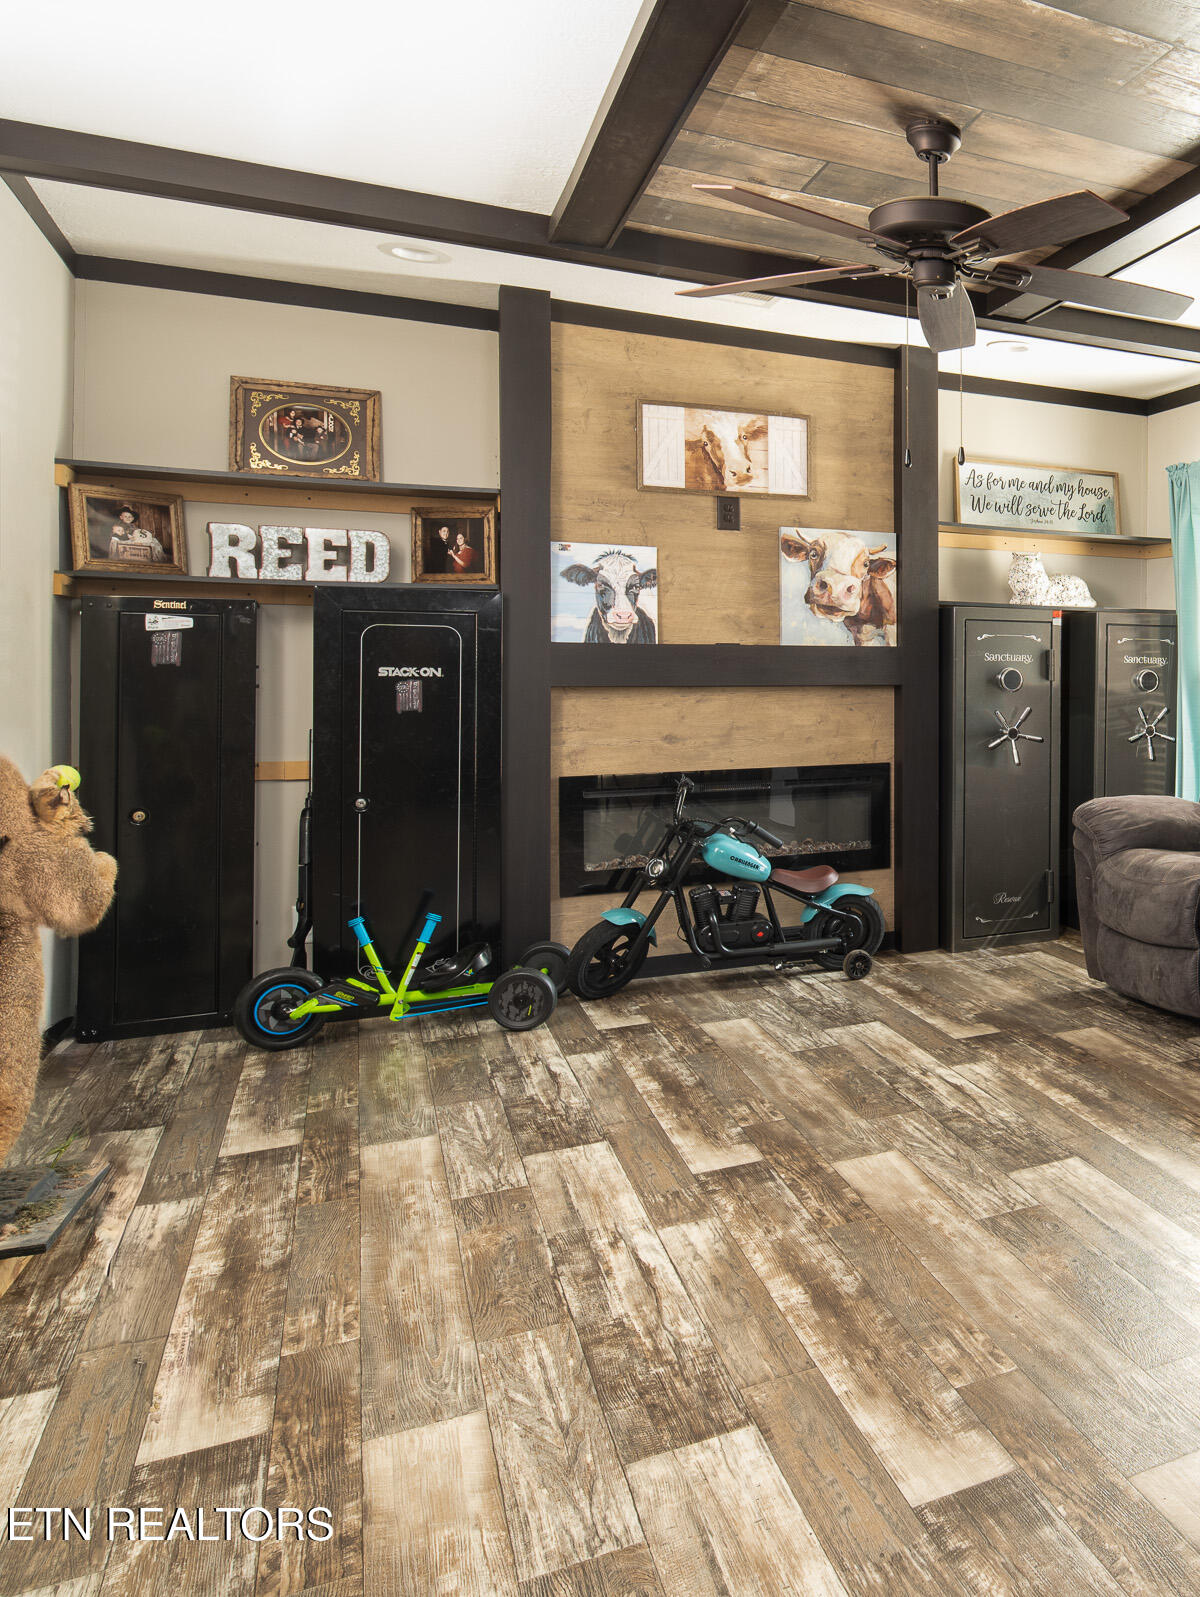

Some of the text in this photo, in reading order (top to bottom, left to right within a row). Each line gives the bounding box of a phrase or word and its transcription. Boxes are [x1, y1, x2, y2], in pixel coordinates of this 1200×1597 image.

[965, 469, 984, 488] As
[986, 472, 1006, 490] for
[1008, 478, 1027, 491] me
[1028, 474, 1055, 494] and
[1056, 482, 1077, 501] my
[970, 494, 993, 513] We
[994, 495, 1023, 516] will
[1025, 503, 1056, 517] serve
[1051, 499, 1077, 520] the
[207, 522, 390, 583] REED
[153, 600, 187, 609] Sentinel
[984, 652, 1034, 664] Sanctuary
[378, 666, 442, 677] STACK-ON
